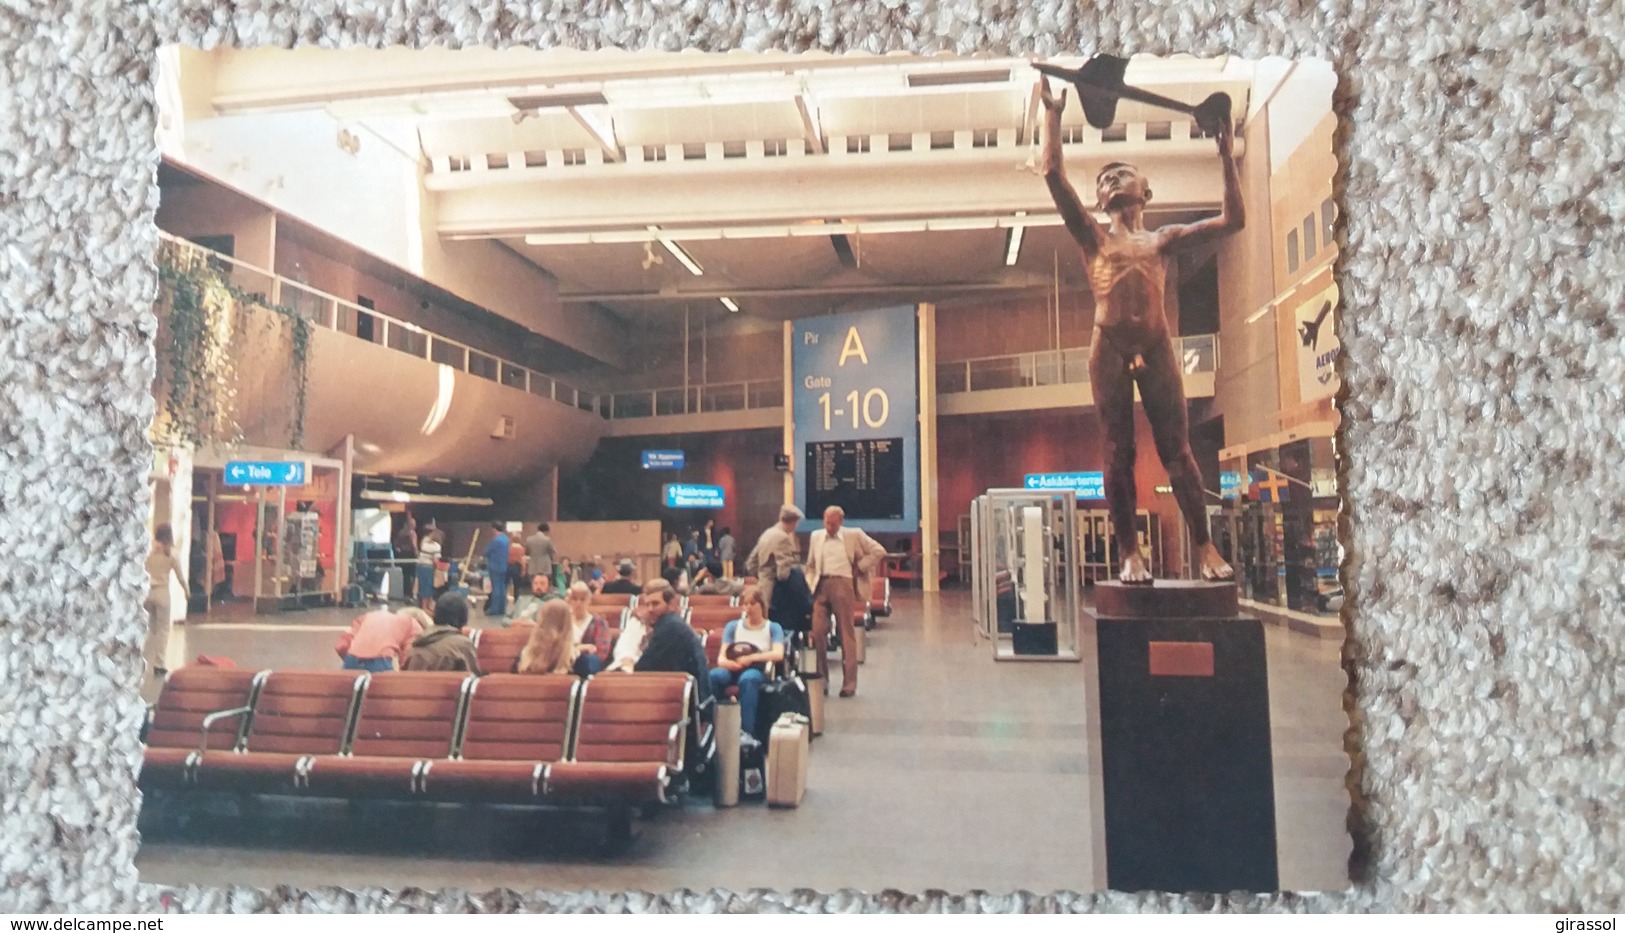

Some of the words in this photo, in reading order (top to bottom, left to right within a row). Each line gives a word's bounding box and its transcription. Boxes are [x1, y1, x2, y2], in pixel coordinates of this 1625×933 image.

[804, 331, 819, 345] Pir
[838, 326, 868, 367] A
[804, 375, 832, 389] Gate
[818, 387, 889, 430] 1-10
[247, 465, 272, 479] Tele
